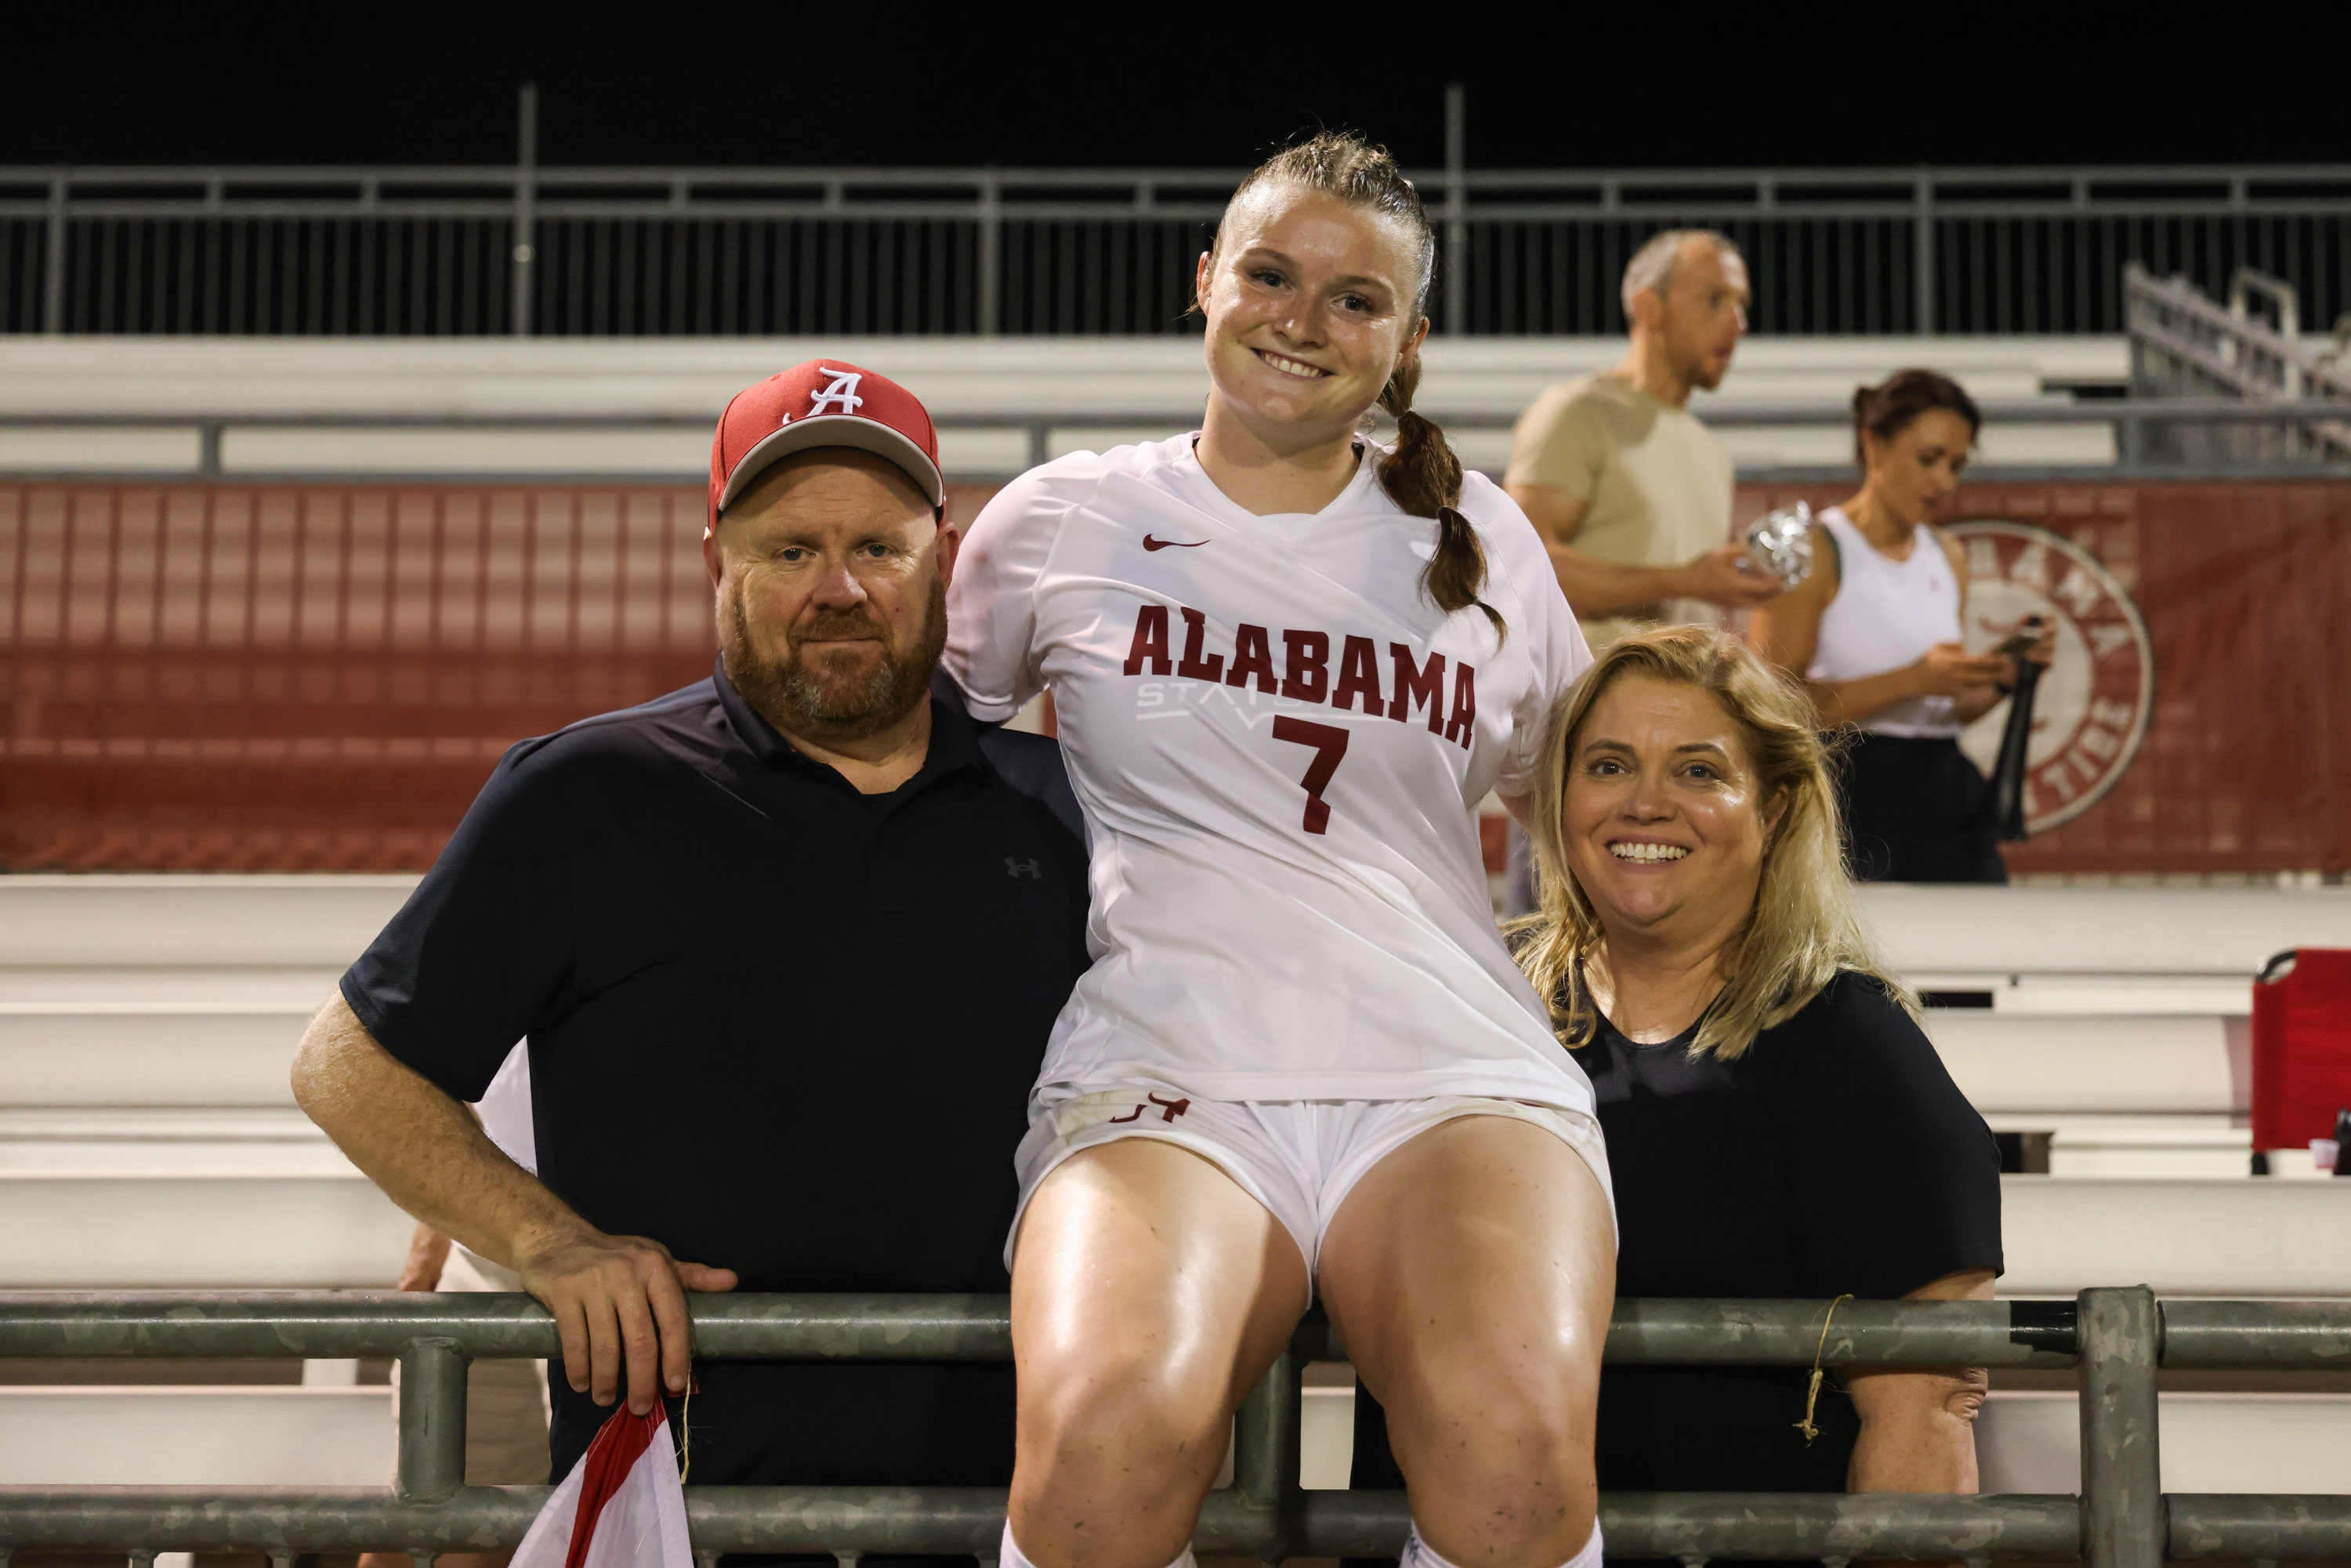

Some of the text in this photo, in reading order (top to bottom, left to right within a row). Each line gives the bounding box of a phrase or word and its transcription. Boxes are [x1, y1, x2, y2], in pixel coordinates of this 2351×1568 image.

[782, 366, 863, 425] A
[1123, 605, 1476, 751] ALABAMA
[1272, 714, 1349, 835] 7
